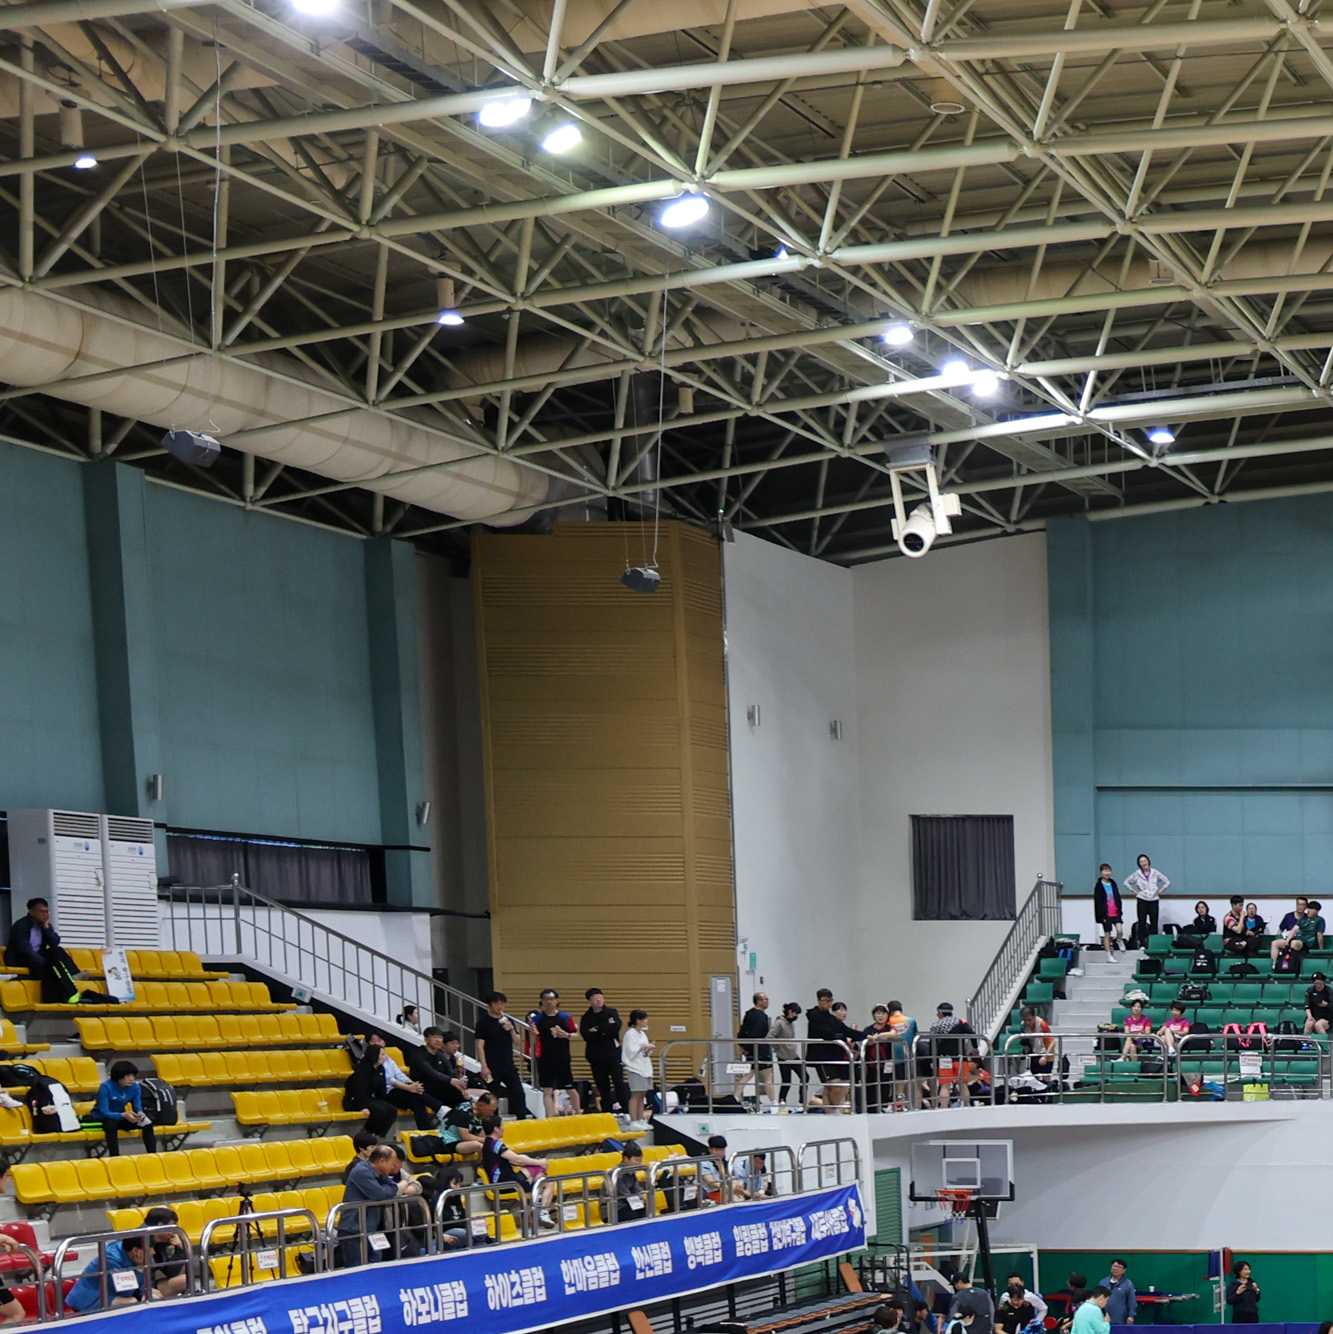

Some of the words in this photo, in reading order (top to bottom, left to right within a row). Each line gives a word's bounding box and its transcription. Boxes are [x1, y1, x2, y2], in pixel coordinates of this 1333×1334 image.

[399, 1279, 468, 1327] 하모니클럽
[484, 1265, 547, 1311] 하이츠클럽
[560, 1252, 621, 1296] 한마음클럽
[631, 1240, 673, 1281] 한신클럽
[683, 1231, 723, 1269] 행복클럽
[733, 1222, 769, 1257] 힐링클럽
